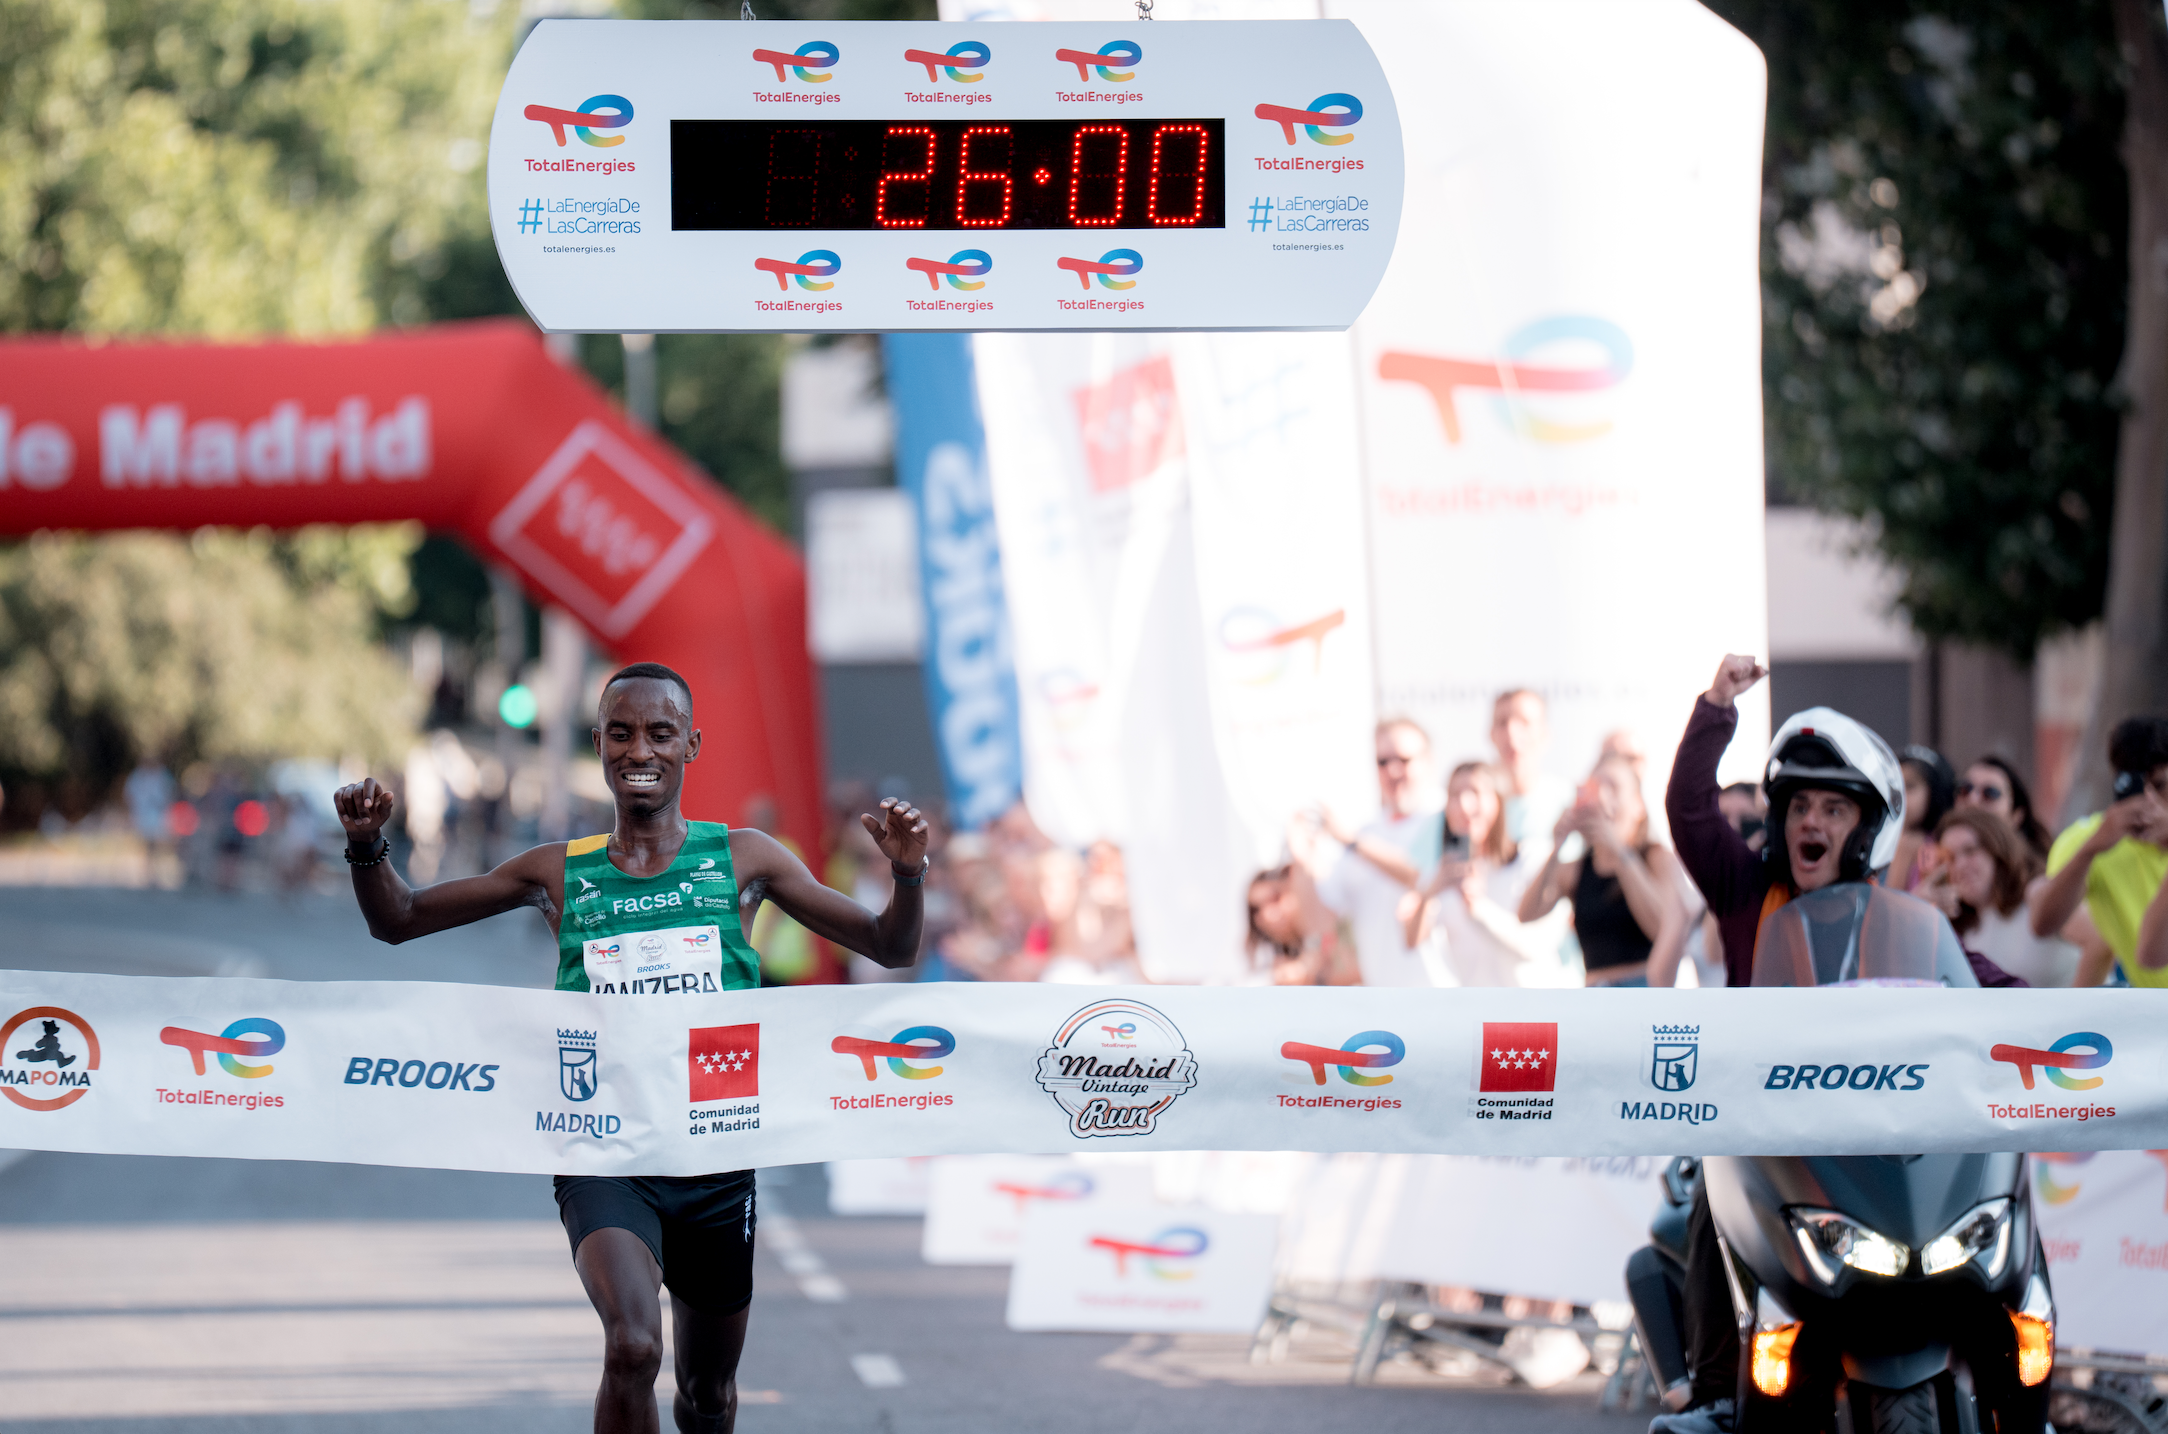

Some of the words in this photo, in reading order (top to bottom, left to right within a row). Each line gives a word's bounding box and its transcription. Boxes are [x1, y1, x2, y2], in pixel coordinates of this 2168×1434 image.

[753, 91, 841, 105] TotalEnergies
[904, 92, 992, 105] TotalEnergies
[1056, 91, 1143, 104] TotalEnergies
[524, 159, 635, 173] TotalEnergies
[1254, 157, 1364, 173] TotalEnergies
[547, 217, 641, 234] LasCarreras
[1277, 215, 1369, 232] LasCarreras
[543, 245, 616, 254] totalenergies.es
[1272, 243, 1344, 252] totalenergies.es
[755, 300, 842, 313] TotalEnergies
[906, 300, 994, 313] TotalEnergies
[1057, 299, 1144, 312] TotalEnergies
[0, 412, 74, 490] e
[100, 397, 432, 488] Madrid
[612, 892, 682, 915] Facsa
[637, 962, 671, 974] BROOKS
[344, 1057, 499, 1092] BROOKS
[1059, 1055, 1177, 1079] Madrid
[0, 1069, 91, 1087] MAPOMA
[1763, 1064, 1930, 1091] BROOKS
[1082, 1079, 1149, 1097] Vintage
[156, 1088, 284, 1111] TotalEnergies
[829, 1092, 954, 1111] TotalEnergies
[1276, 1094, 1402, 1112] TotalEnergies
[1477, 1098, 1554, 1108] Comunidad
[689, 1103, 760, 1121] Comunidad
[1077, 1098, 1149, 1131] Run
[1476, 1110, 1494, 1120] de
[1500, 1109, 1552, 1120] Madrid
[1620, 1102, 1718, 1126] MADRID
[1987, 1103, 2116, 1122] TotalEnergies
[536, 1111, 621, 1139] MADRID
[689, 1124, 706, 1136] de
[712, 1118, 760, 1134] Madrid
